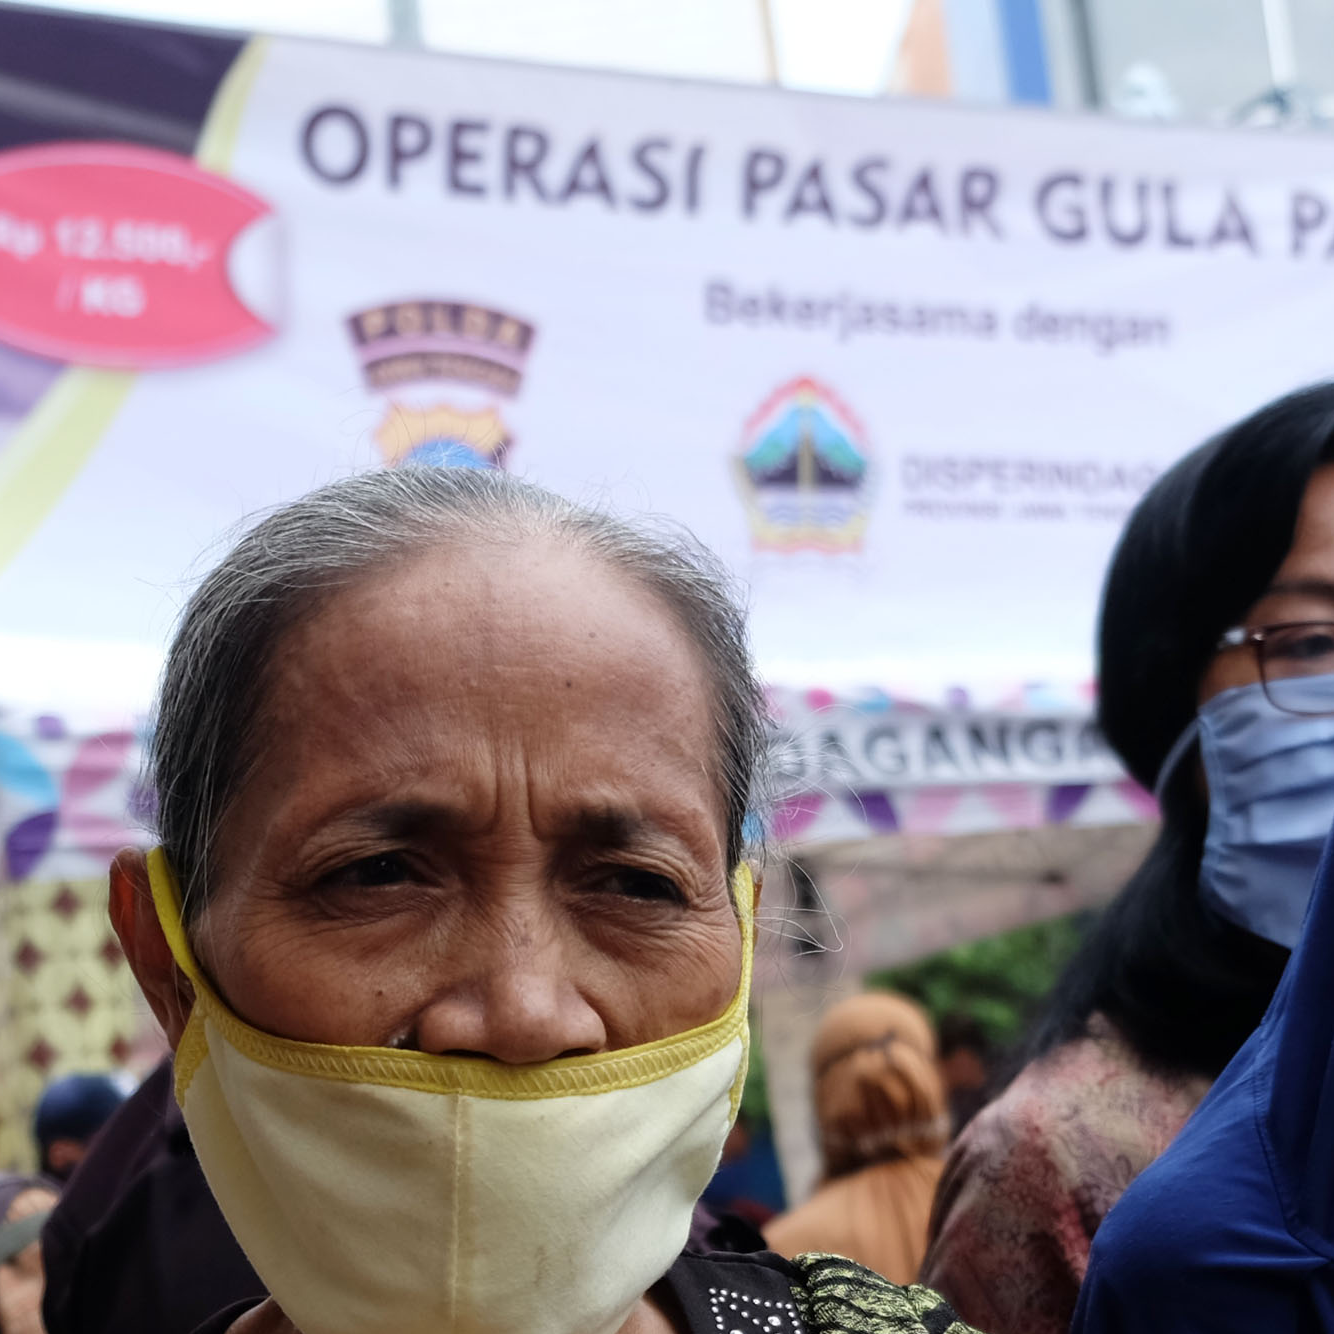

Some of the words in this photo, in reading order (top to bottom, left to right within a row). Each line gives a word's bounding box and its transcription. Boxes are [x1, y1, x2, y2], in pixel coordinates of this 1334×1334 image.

[300, 104, 705, 219] OPERASI
[742, 147, 1005, 240] PASAR
[1032, 172, 1259, 258] GULA
[703, 277, 998, 344] Bekerjasama
[1013, 299, 1169, 357] dengan
